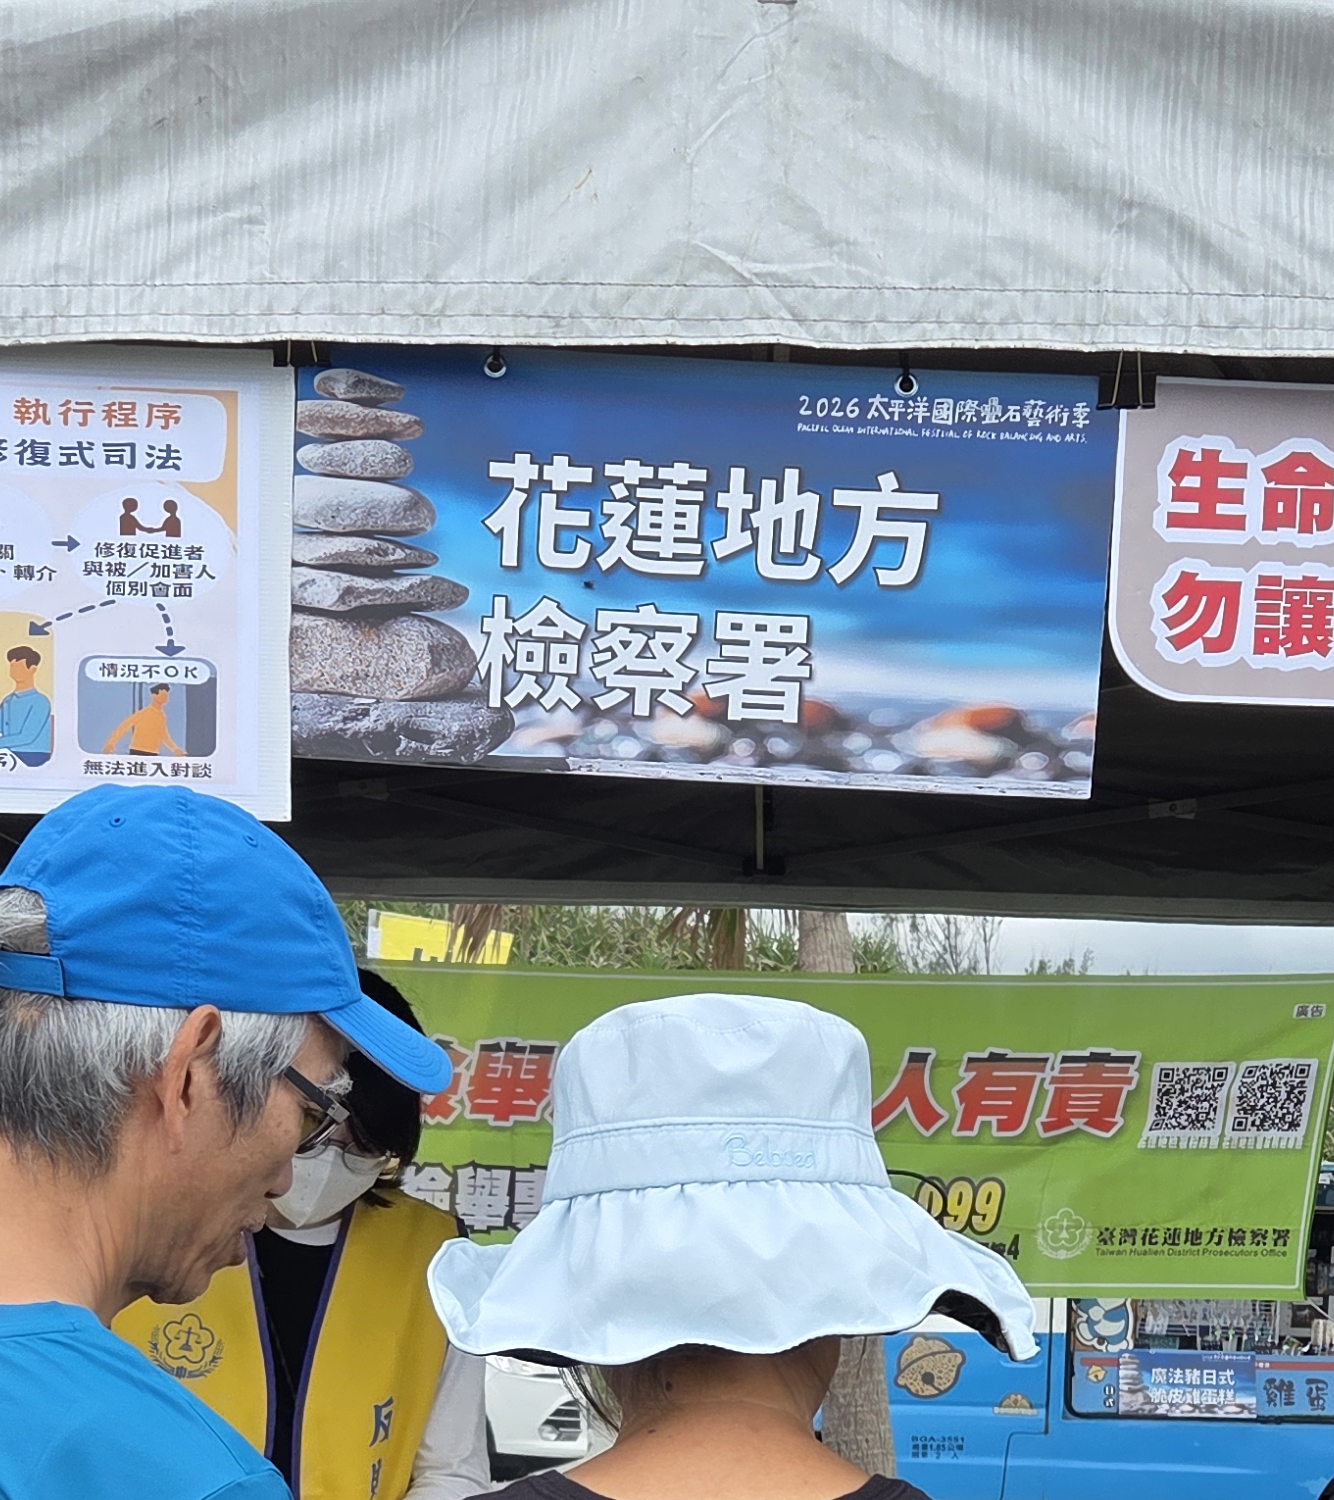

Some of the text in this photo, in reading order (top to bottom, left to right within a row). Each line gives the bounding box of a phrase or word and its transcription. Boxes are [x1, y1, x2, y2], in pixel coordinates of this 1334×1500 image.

[799, 395, 860, 418] 2026
[484, 451, 940, 588] 花蓮地方
[95, 541, 205, 561] 修復促進者
[106, 580, 193, 599] 個別會面
[476, 595, 813, 724] 檢察署
[83, 759, 213, 779] 無法進入對談
[1295, 1004, 1324, 1018] 廣告
[872, 1050, 1140, 1137] 人有責
[1096, 1227, 1291, 1247] 臺灣花蓮地方檢察署
[1095, 1247, 1287, 1257] Taiwan Hualien District Prosecutors Office
